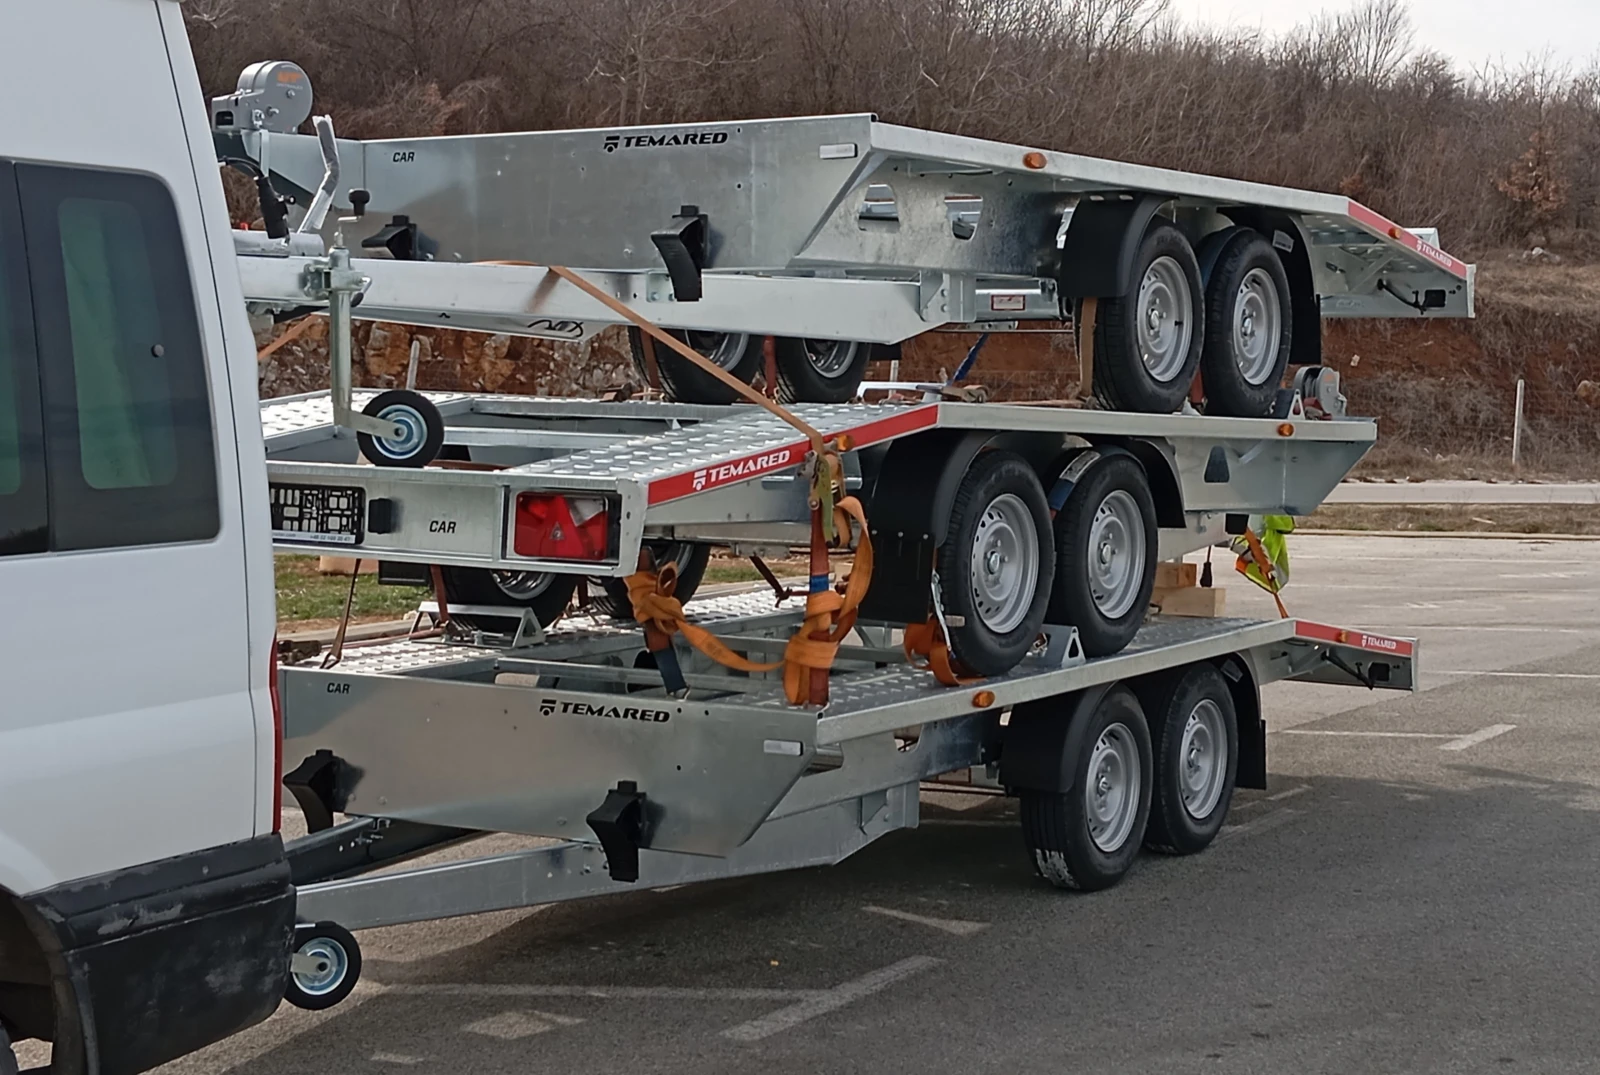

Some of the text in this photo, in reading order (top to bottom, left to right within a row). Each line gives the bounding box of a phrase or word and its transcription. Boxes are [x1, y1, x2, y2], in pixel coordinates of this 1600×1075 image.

[623, 132, 728, 148] TEMARED
[392, 151, 415, 163] CAR
[1422, 243, 1453, 268] TEMARED
[709, 450, 790, 483] TEMARED
[429, 520, 457, 534] CAR
[1367, 636, 1397, 650] TEMARED
[326, 682, 351, 695] CAR
[560, 701, 670, 723] TEMARED
